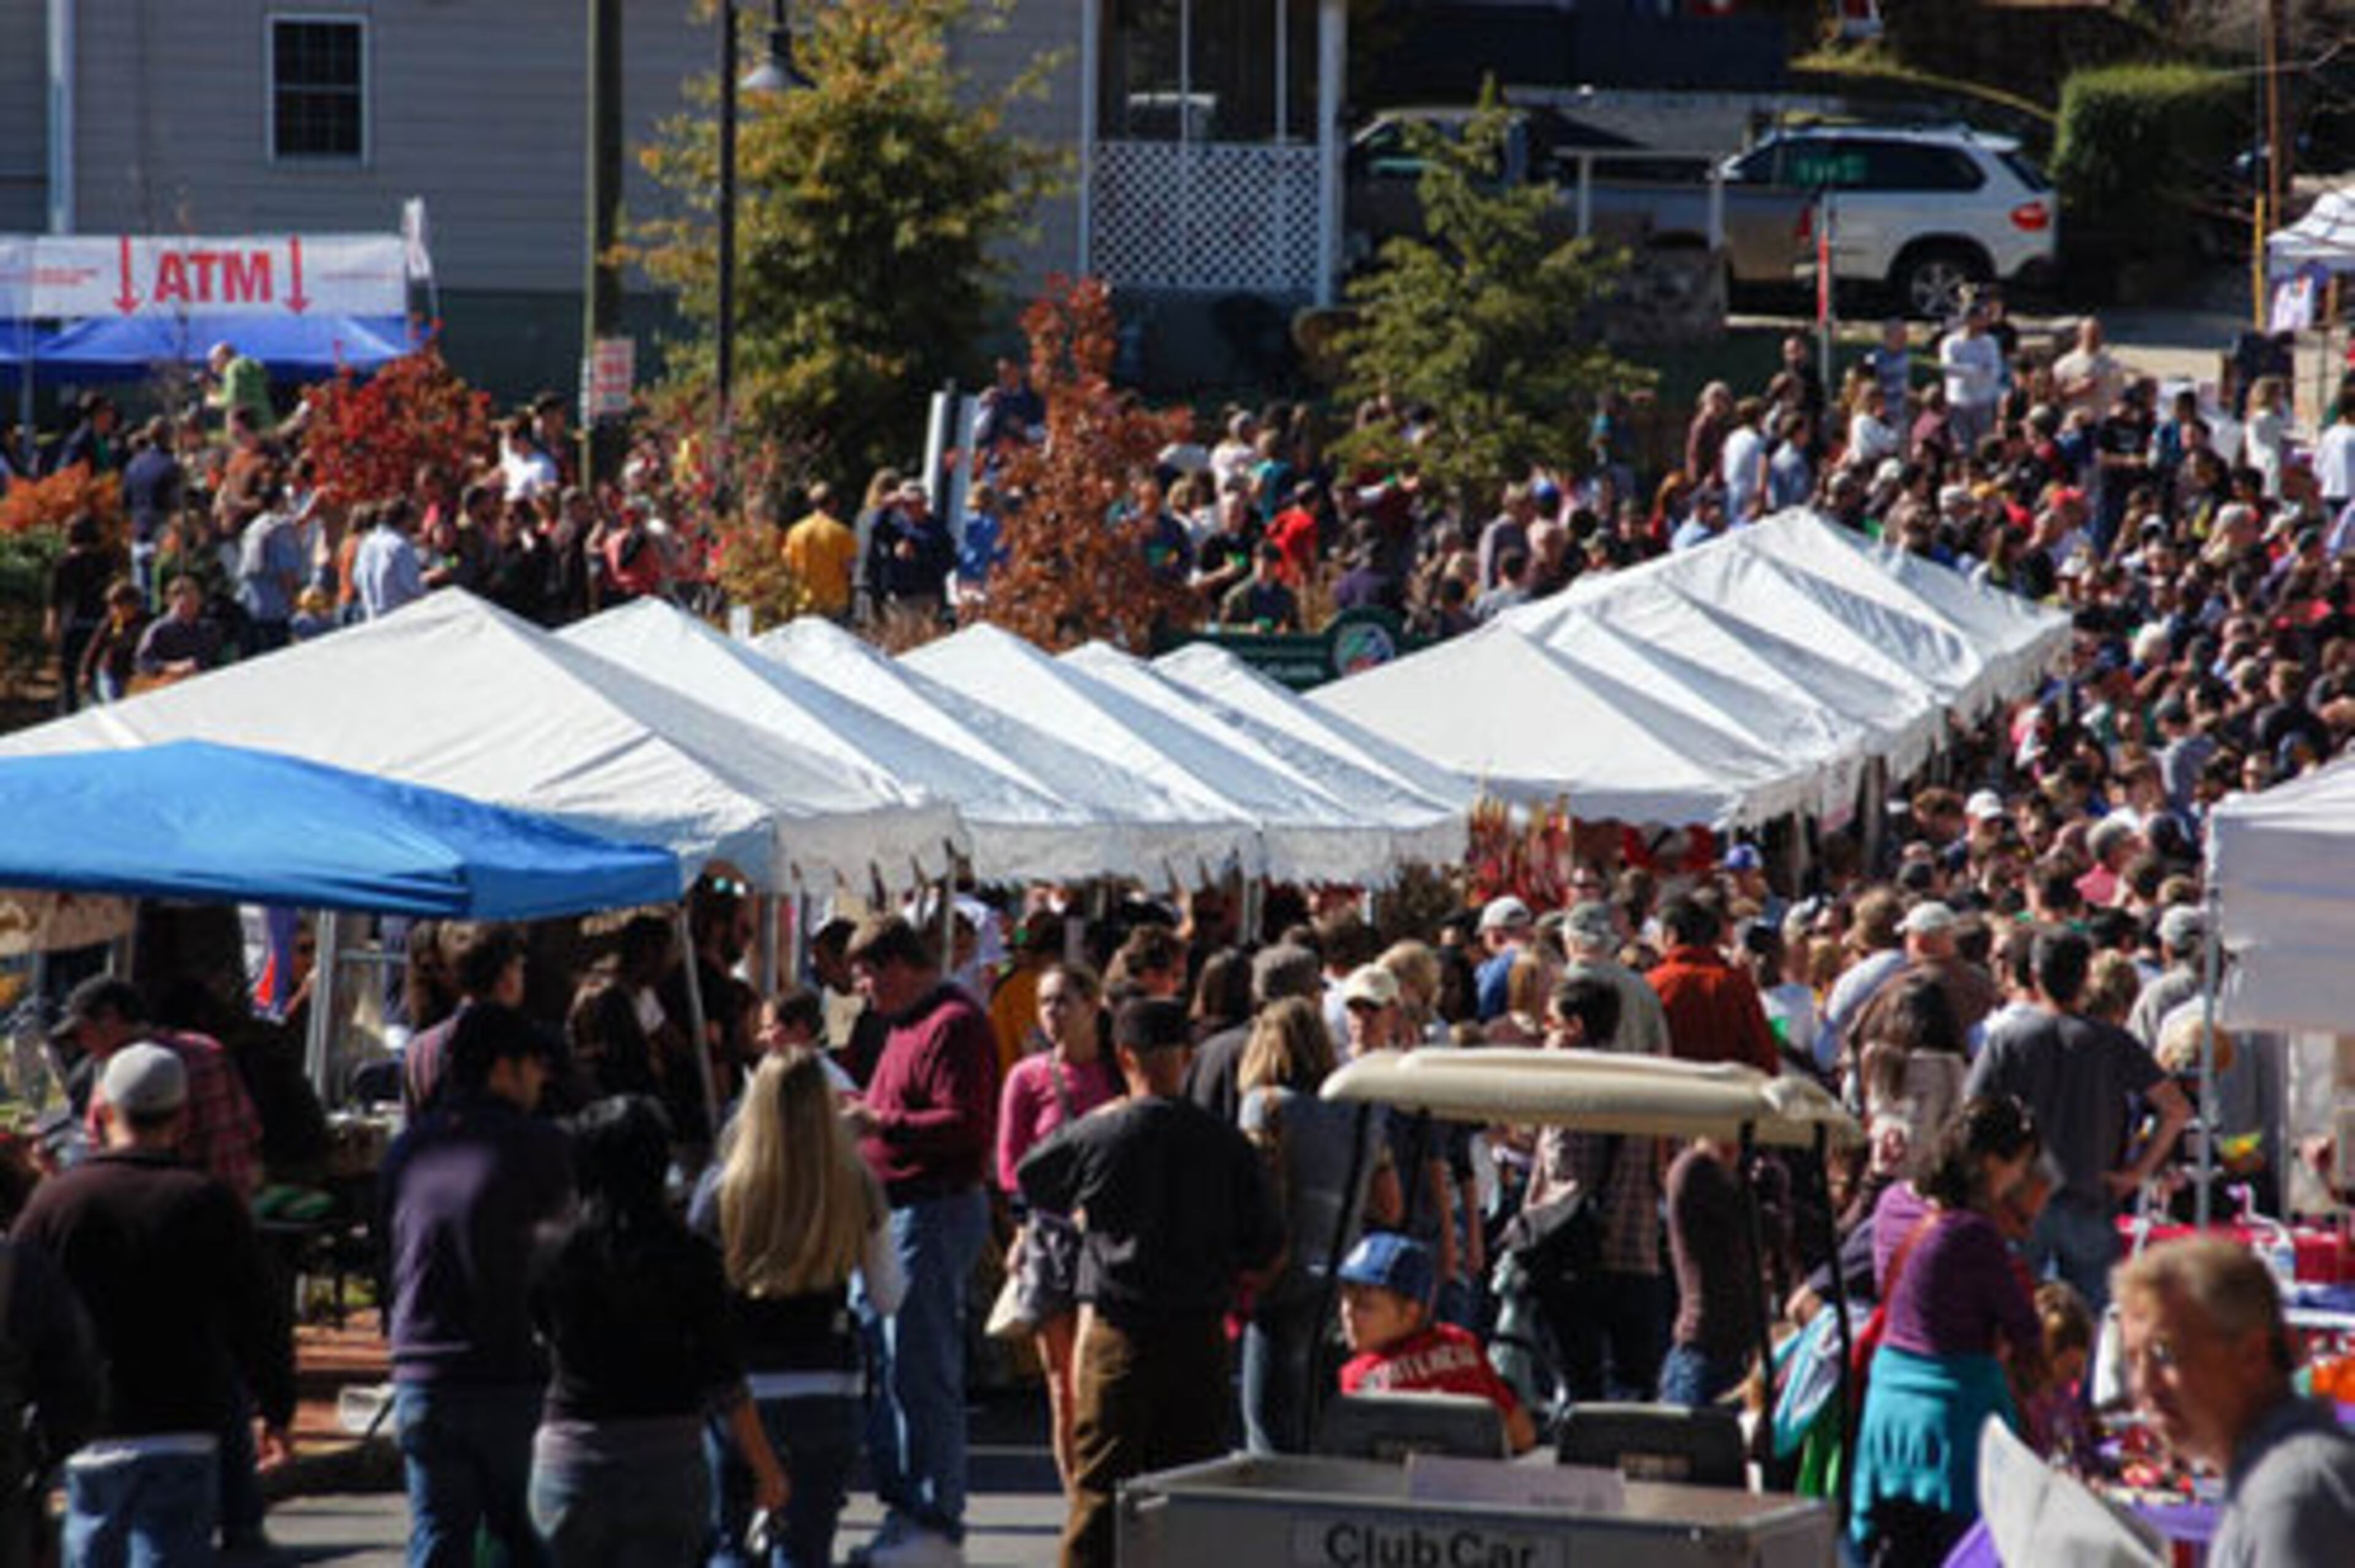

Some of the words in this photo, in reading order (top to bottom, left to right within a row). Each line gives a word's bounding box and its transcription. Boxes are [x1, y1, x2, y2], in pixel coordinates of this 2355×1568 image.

[155, 251, 272, 302] ATM
[1325, 1523, 1439, 1568] Club
[1449, 1531, 1534, 1568] Car
